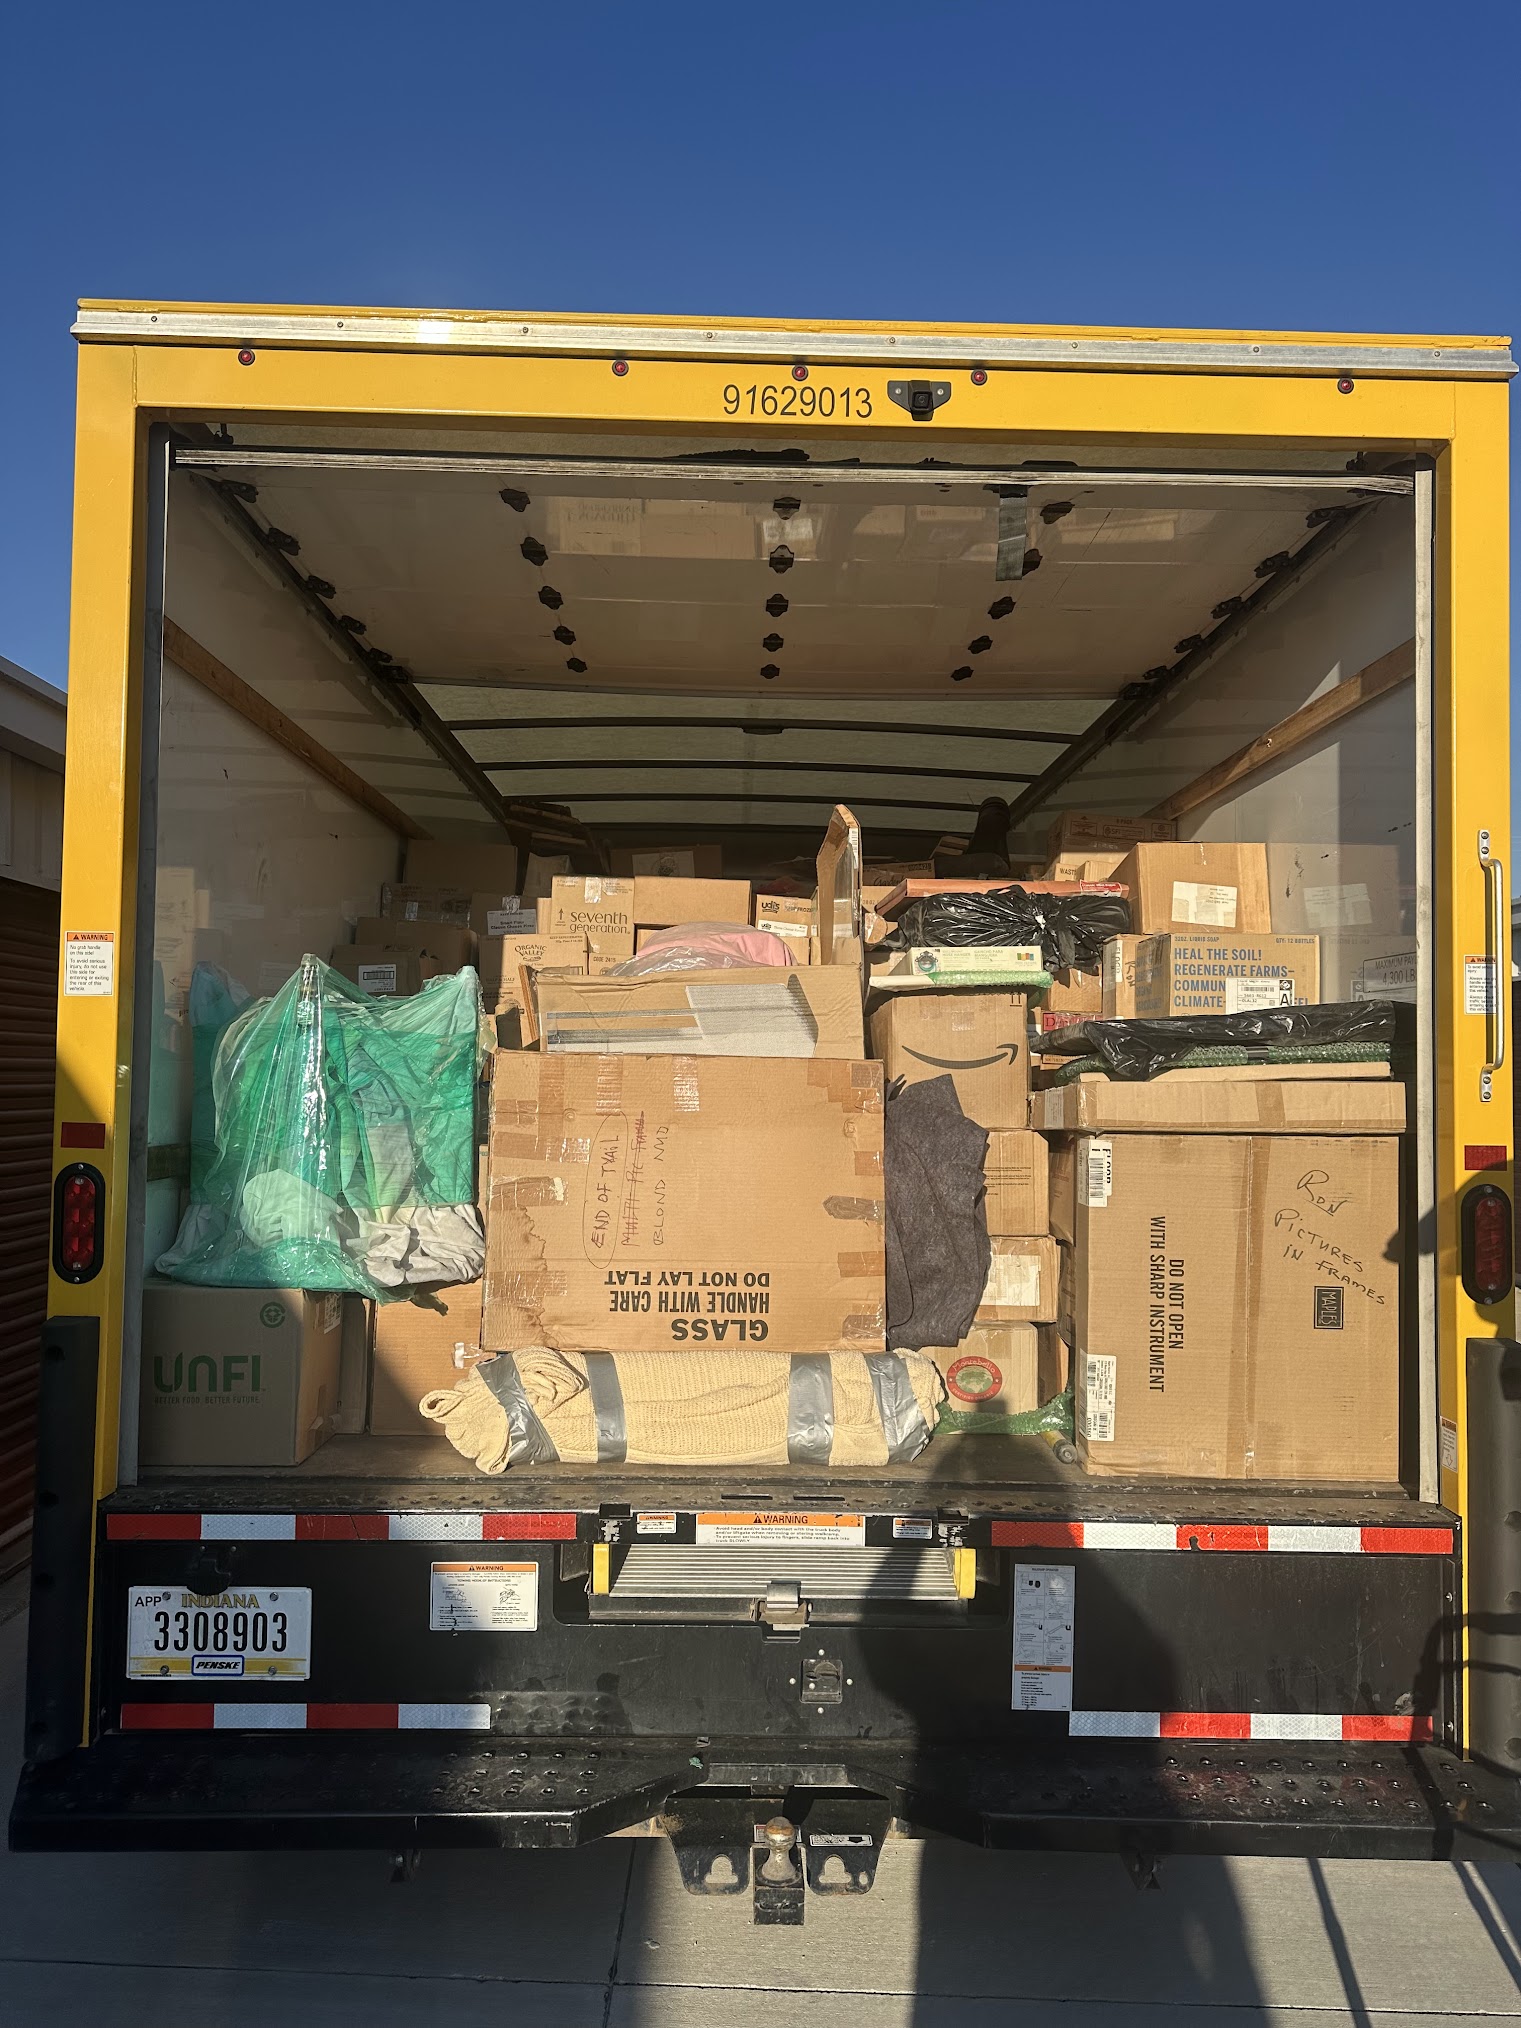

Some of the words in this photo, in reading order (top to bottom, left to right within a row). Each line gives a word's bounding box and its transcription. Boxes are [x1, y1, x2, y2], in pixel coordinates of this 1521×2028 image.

[723, 384, 873, 418] 91629013
[570, 911, 627, 925] seventh
[569, 923, 627, 934] generation
[515, 944, 547, 952] ORGANIC
[1174, 948, 1203, 960] HEAL
[1207, 949, 1228, 960] THE
[1232, 949, 1262, 960] SOIL!
[1174, 964, 1247, 976] REGENERATE
[1376, 957, 1403, 969] MAXIMUM
[1383, 970, 1403, 985] 4,300
[1174, 980, 1226, 991] COMMUN
[1280, 994, 1289, 1005] A
[597, 1183, 612, 1202] OF
[654, 1180, 666, 1245] BLOND
[591, 1210, 611, 1248] END
[1150, 1216, 1166, 1249] WITH
[1169, 1260, 1184, 1277] DO
[604, 1271, 652, 1286] FLAT
[657, 1272, 692, 1286] LAY
[699, 1272, 737, 1286] NOT
[744, 1272, 770, 1287] DO
[1150, 1255, 1165, 1300] SHARP
[609, 1291, 650, 1312] CARE
[658, 1291, 700, 1312] WITH
[707, 1292, 769, 1313] HANDLE
[1169, 1282, 1184, 1310] NOT
[1319, 1291, 1337, 1325] MAPLES
[671, 1318, 769, 1341] GLASS
[1168, 1314, 1184, 1349] OPEN
[1150, 1305, 1165, 1392] INSTRUMENT
[952, 1359, 995, 1373] Montebello
[764, 1515, 808, 1524] WARNING
[135, 1596, 162, 1607] APP
[181, 1594, 260, 1608] INDIANA
[154, 1611, 287, 1652] 3308903
[196, 1661, 240, 1670] PENSKE
